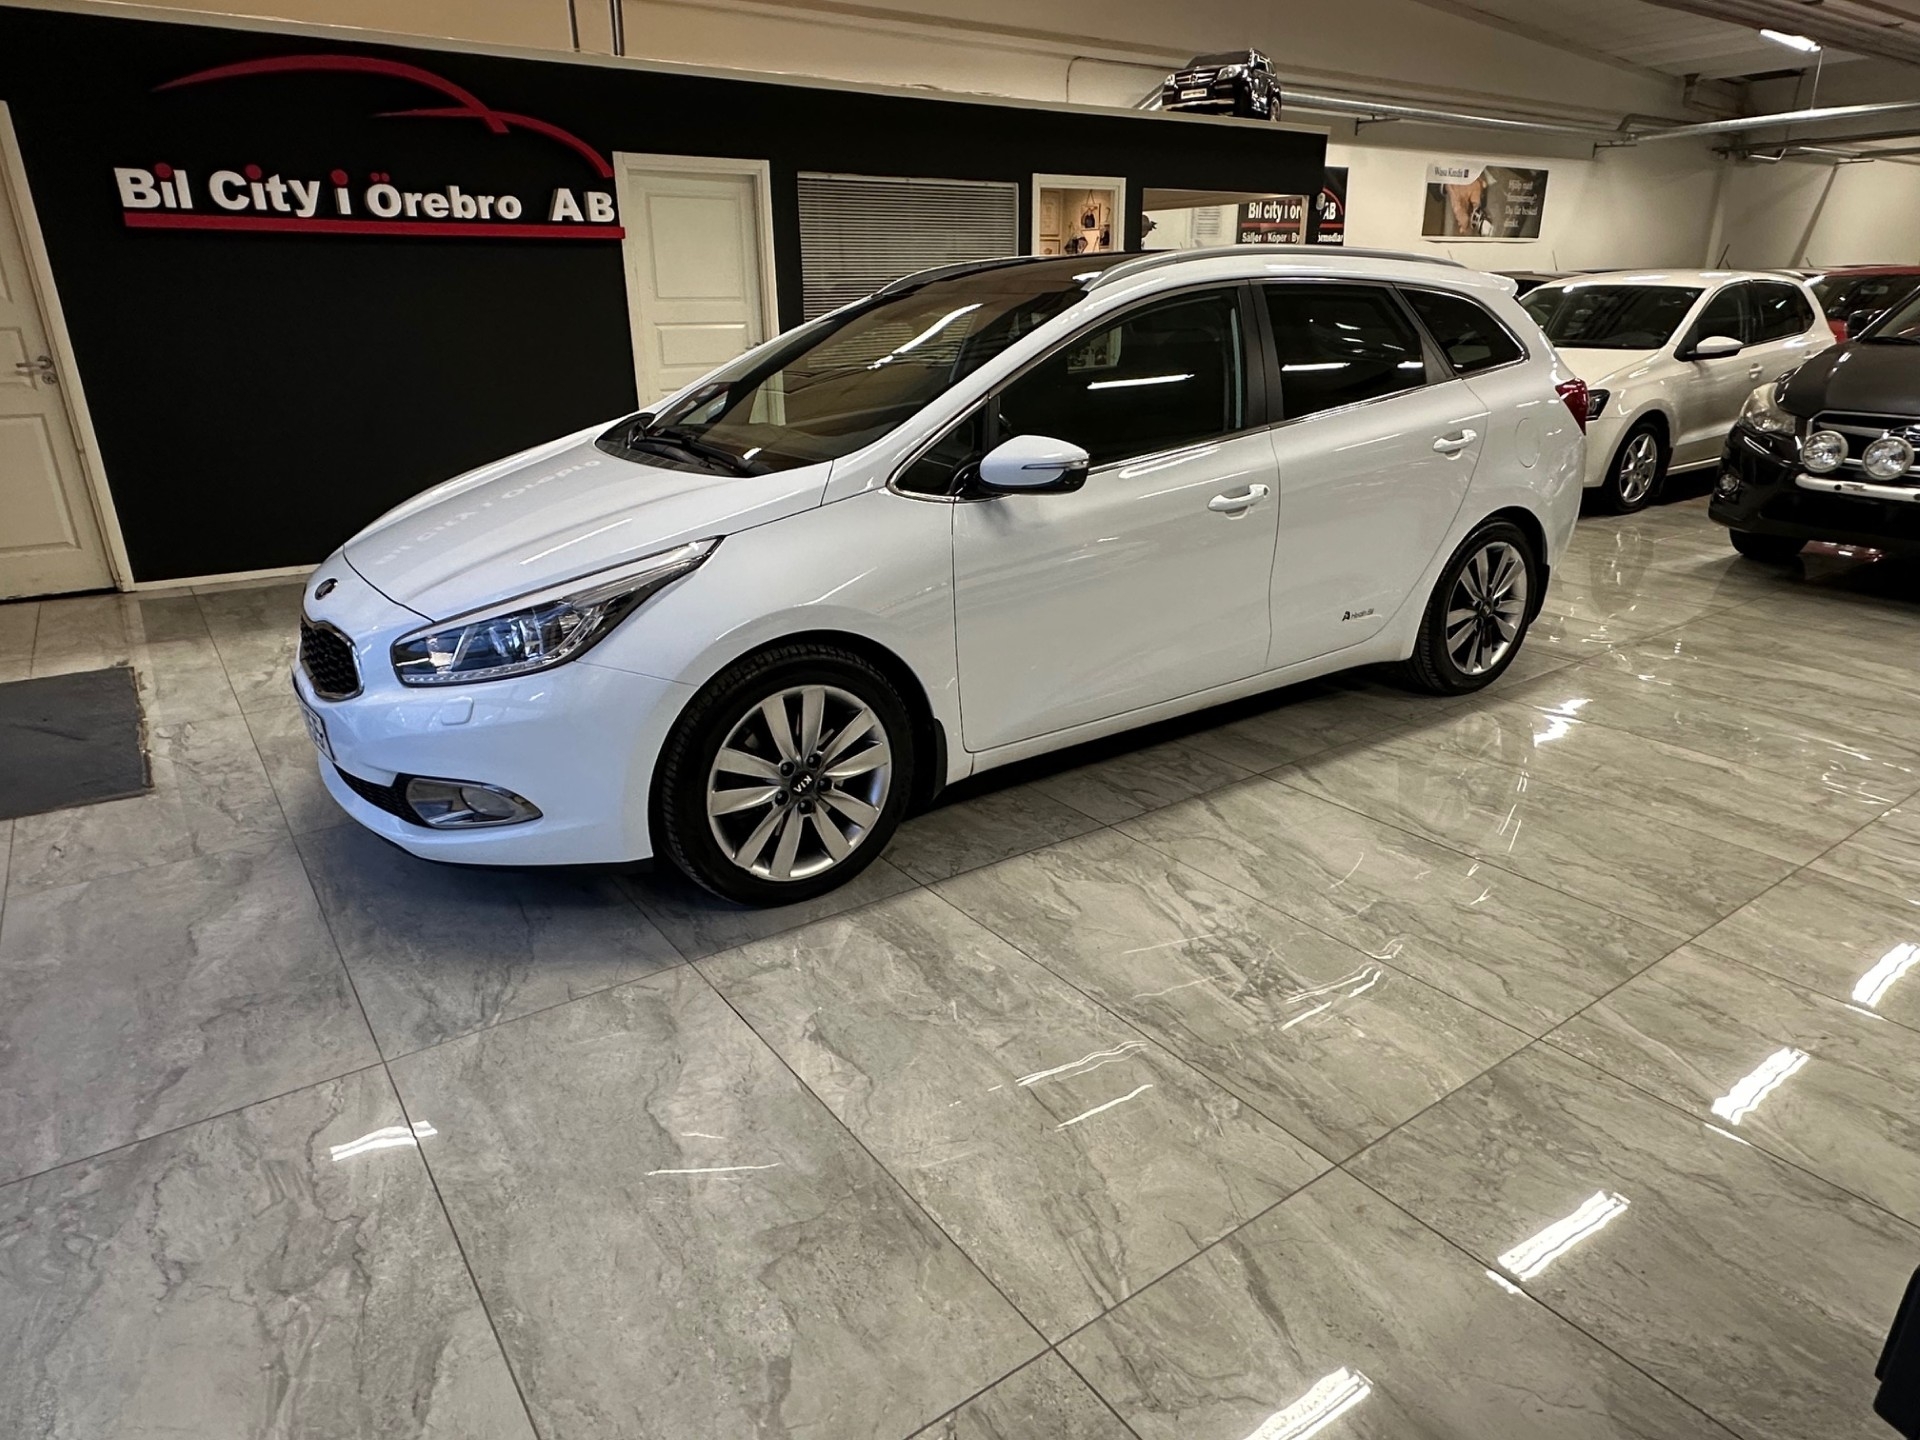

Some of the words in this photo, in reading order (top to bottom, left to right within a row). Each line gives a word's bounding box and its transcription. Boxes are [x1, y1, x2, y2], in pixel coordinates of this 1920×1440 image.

[113, 162, 193, 210] Bil
[208, 164, 320, 218] City
[330, 168, 352, 215] i
[364, 172, 522, 220] Örebro
[550, 187, 616, 223] AB
[1248, 201, 1262, 219] Bil
[1291, 232, 1300, 244] By
[793, 775, 812, 793] KIA
